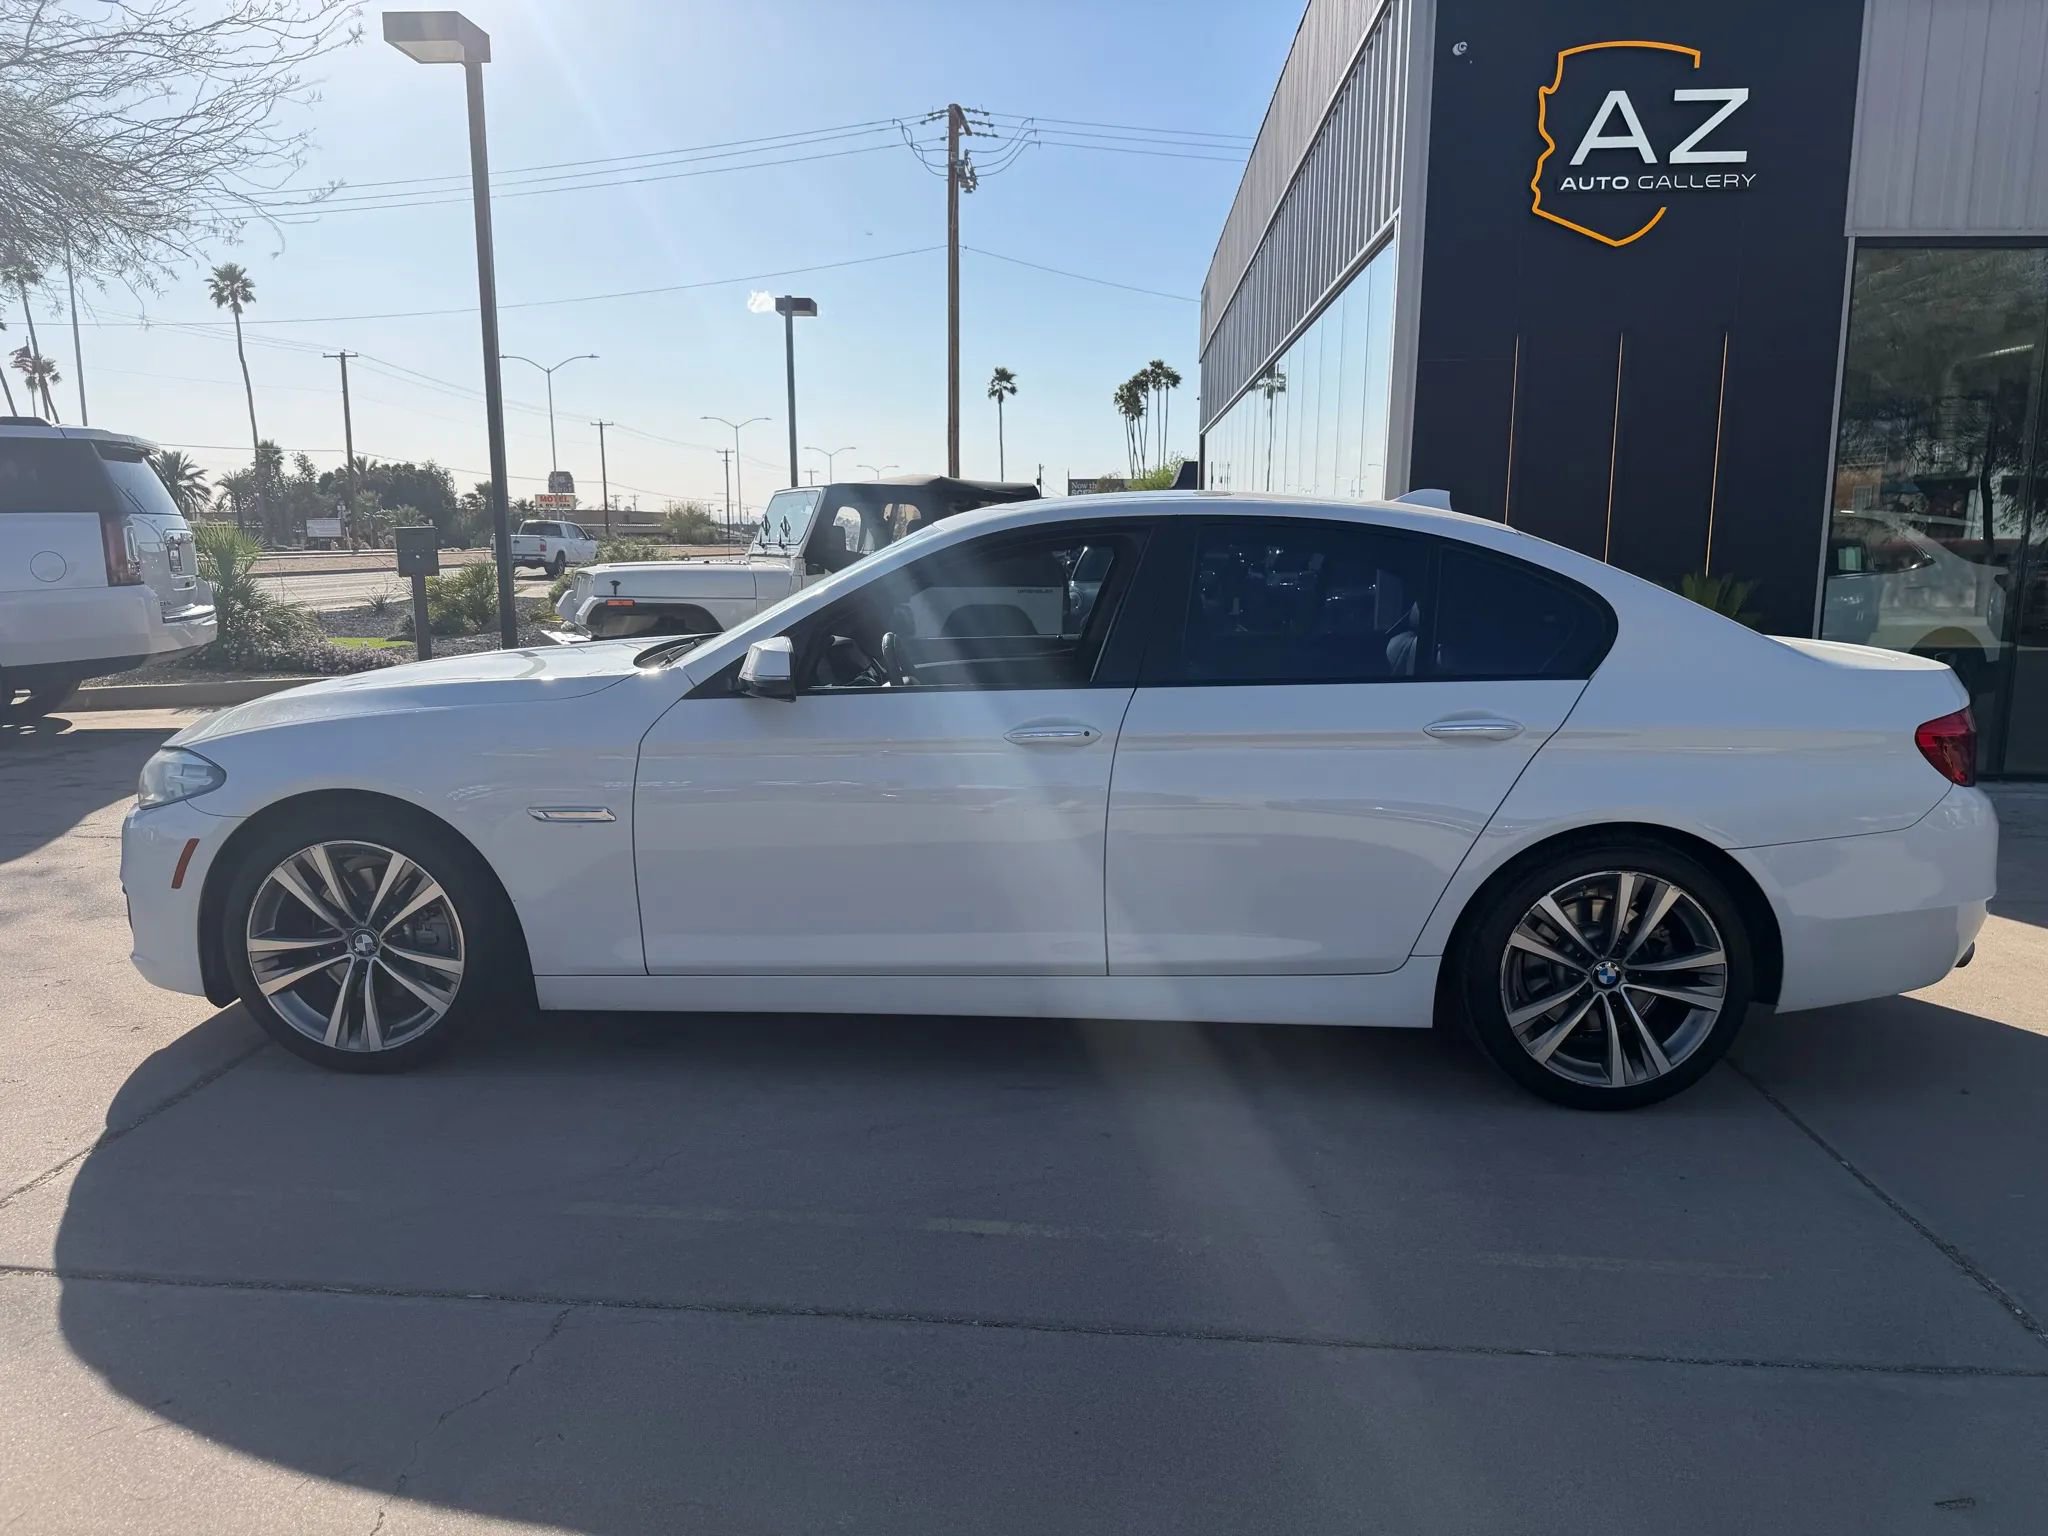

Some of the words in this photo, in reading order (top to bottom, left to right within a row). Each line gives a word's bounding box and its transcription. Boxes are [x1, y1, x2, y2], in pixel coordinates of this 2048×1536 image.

[1569, 88, 1749, 165] AZ
[1560, 176, 1630, 191] AUTO
[1637, 173, 1757, 190] GALLERY
[1071, 481, 1087, 489] Now
